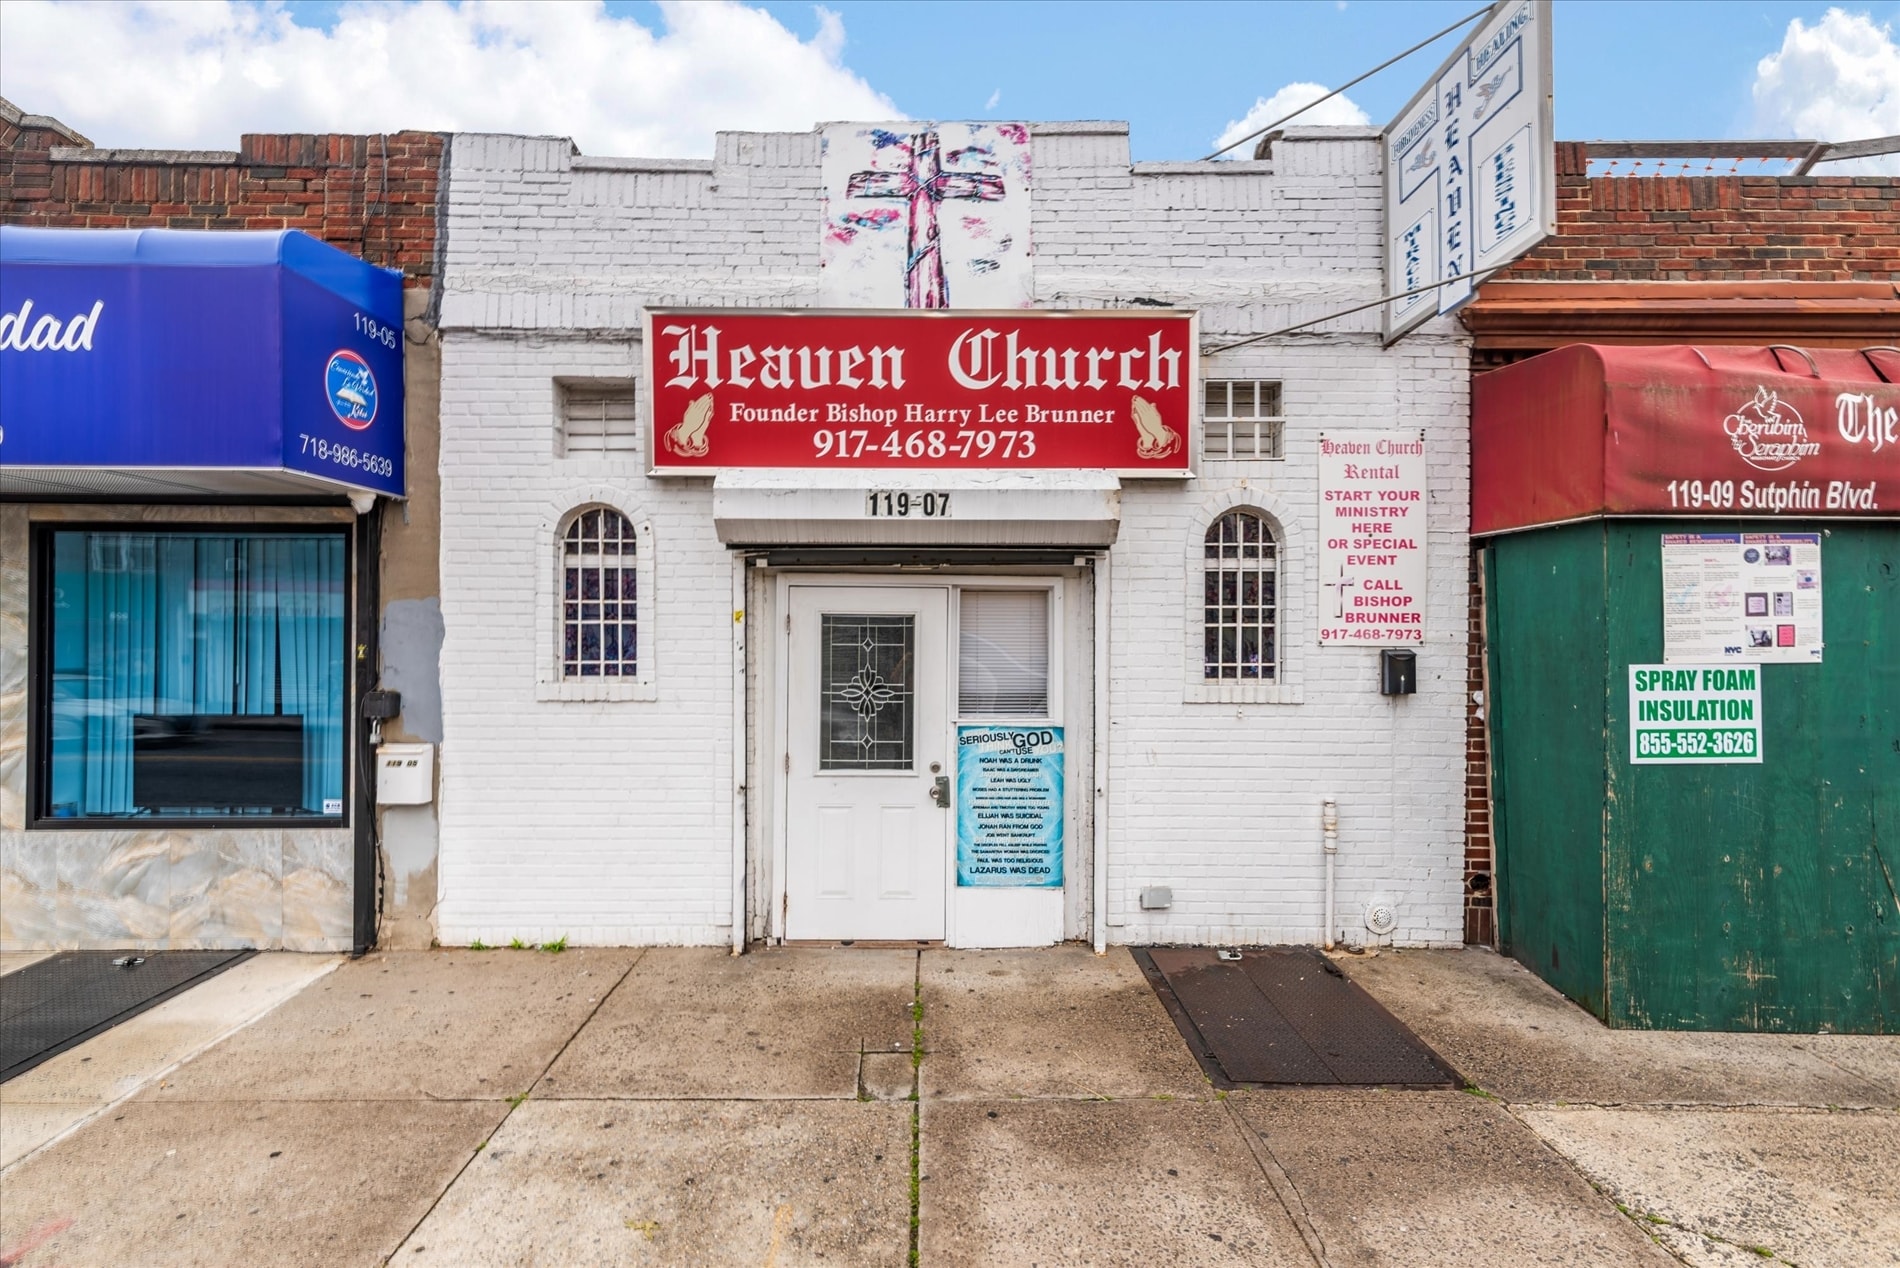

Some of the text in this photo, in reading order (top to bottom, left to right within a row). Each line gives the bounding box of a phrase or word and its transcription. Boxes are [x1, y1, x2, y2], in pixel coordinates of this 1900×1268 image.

[1476, 6, 1528, 70] HEALING
[1444, 82, 1463, 288] HEAVEN
[353, 312, 396, 349] 119-05
[661, 325, 1182, 391] Heaven Church
[730, 404, 1115, 427] Founder Bishop Harry Lee Brunner
[1723, 414, 1804, 436] Cherubim
[1836, 392, 1898, 453] The
[300, 433, 393, 477] 718-986-5639
[813, 430, 1036, 459] 917-468-7973
[1321, 439, 1423, 457] Heaven Church
[1738, 434, 1820, 457] Seraphim
[1344, 464, 1399, 479] Rental
[868, 493, 950, 516] 119-07
[1325, 491, 1420, 501] START YOUR
[1667, 480, 1878, 513] 119-09 Sutphin Blvd.
[1335, 507, 1409, 517] MINISTRY
[1352, 523, 1392, 533] HERE
[1328, 539, 1417, 549] OR SPECIAL
[1347, 555, 1397, 565] EVENT
[1363, 580, 1403, 590] CALL
[1354, 596, 1412, 606] BISHOP
[1345, 613, 1421, 623] BRUNNER
[1321, 629, 1422, 640] 917-468-7973
[1635, 670, 1756, 691] SPRAY FOAM
[1639, 700, 1753, 722] INSULATION
[960, 731, 1053, 748] SERIOUSLY GOD
[1640, 732, 1754, 754] 855-552-3626
[1016, 747, 1033, 755] USE
